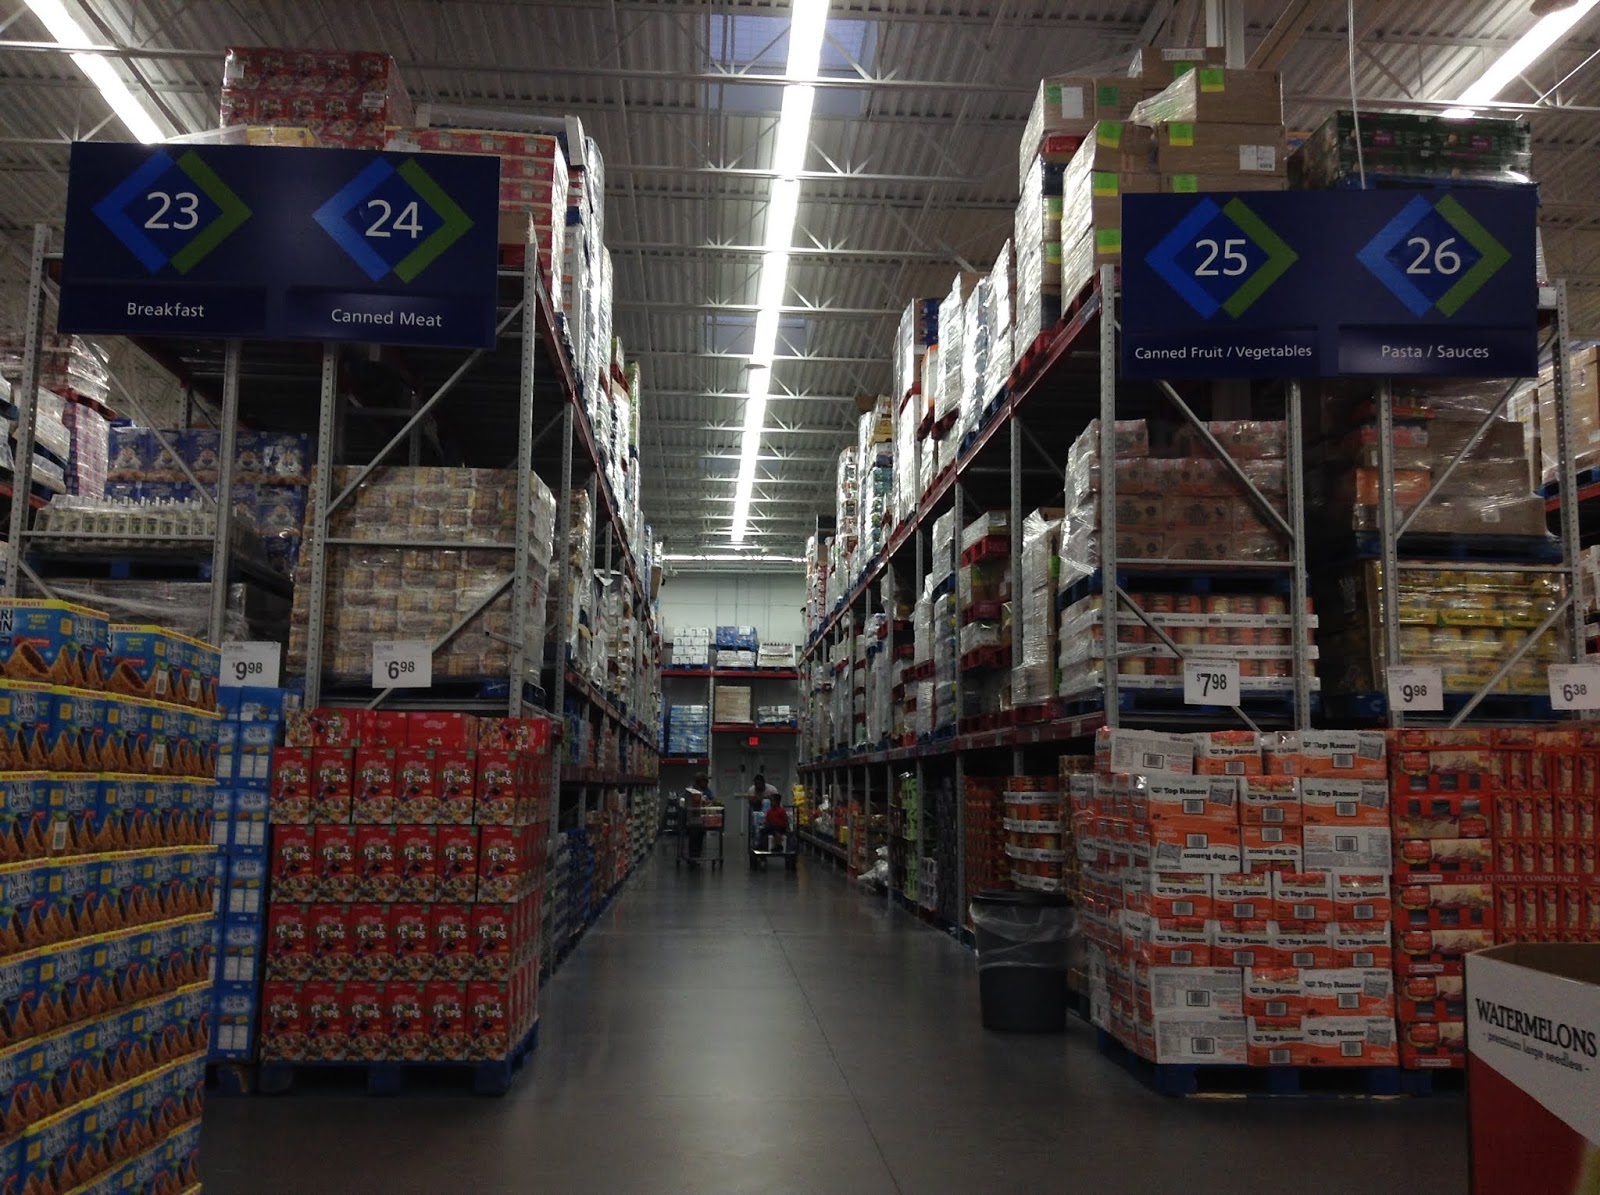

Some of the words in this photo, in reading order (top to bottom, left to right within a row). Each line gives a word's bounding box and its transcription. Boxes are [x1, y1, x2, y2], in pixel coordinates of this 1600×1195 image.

[144, 191, 201, 231] 23
[365, 199, 424, 239] 24
[1194, 238, 1249, 276] 25
[1406, 236, 1462, 275] 26
[127, 301, 205, 318] Breakfast
[331, 308, 394, 326] Canned
[399, 311, 443, 329] Meat
[1134, 346, 1187, 360] Canned
[1190, 346, 1223, 359] Fruit
[1234, 344, 1313, 362] Vegetables
[1381, 344, 1423, 359] Pasta
[1437, 344, 1490, 359] Sauces
[1164, 787, 1179, 795] Top
[1180, 787, 1207, 795] Ramen
[1475, 997, 1598, 1058] WATERMELONS
